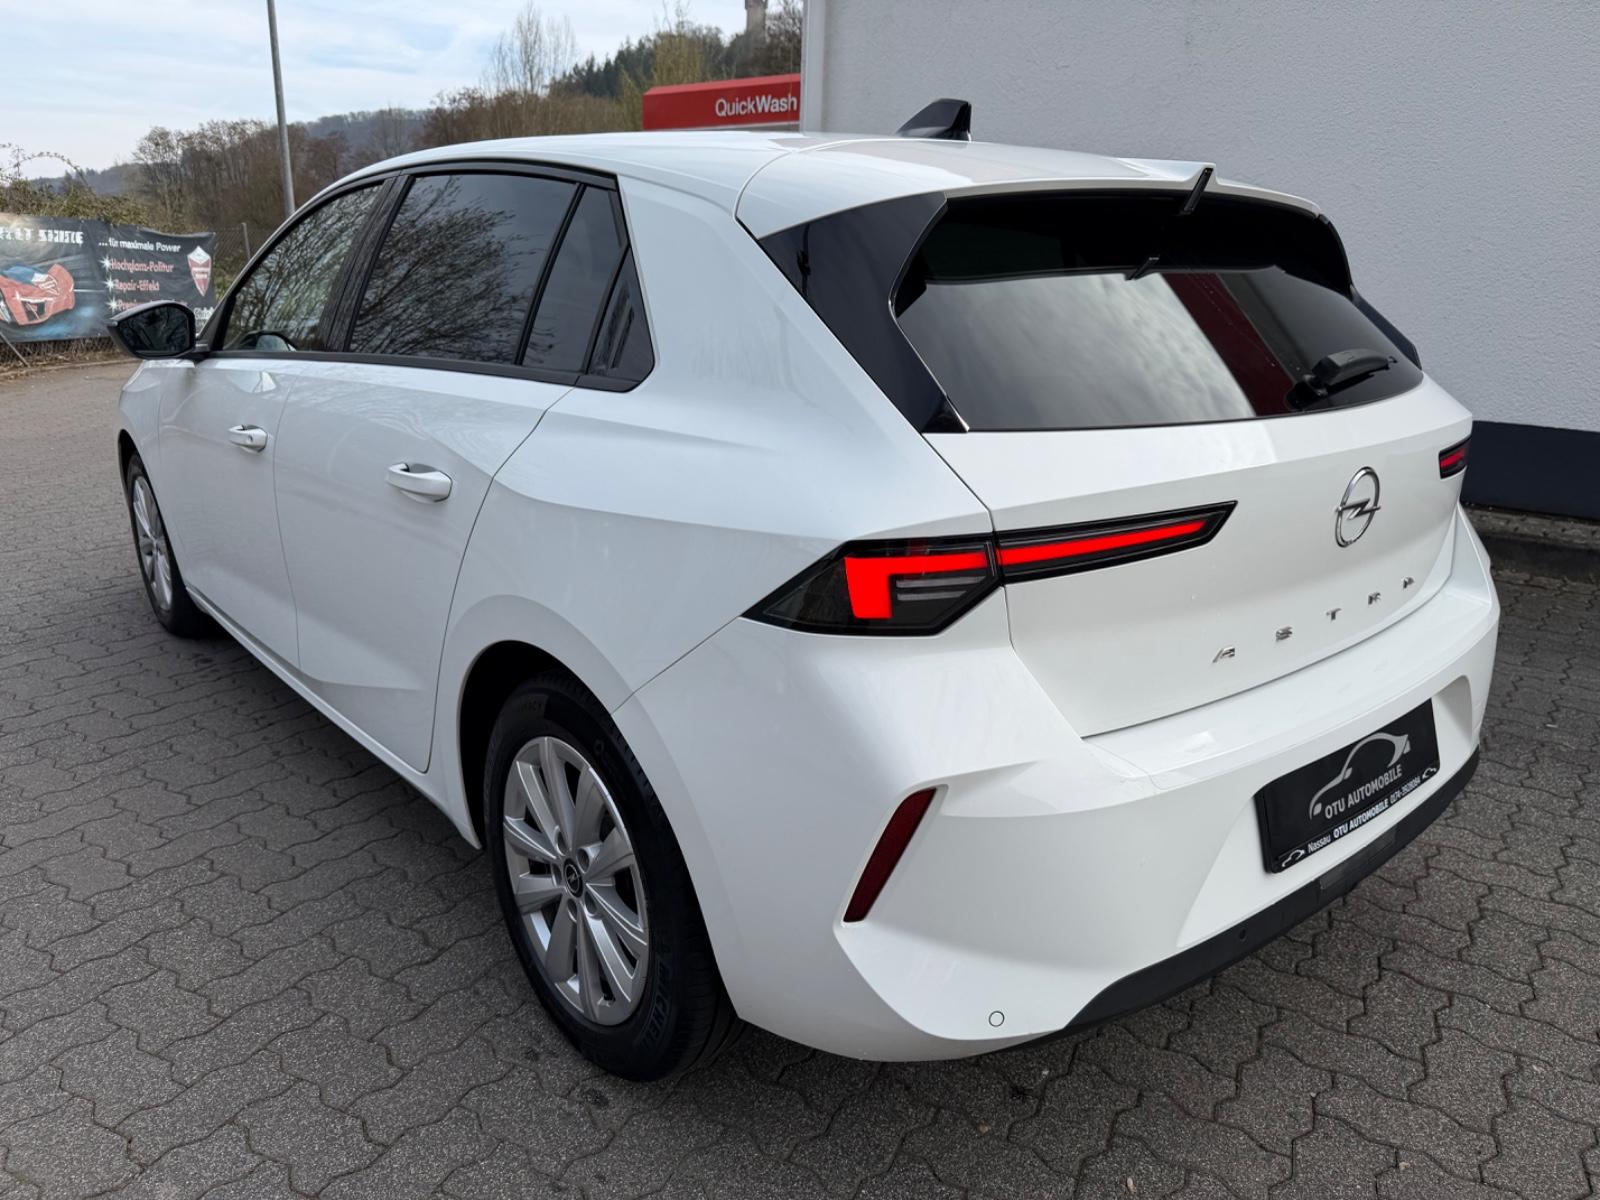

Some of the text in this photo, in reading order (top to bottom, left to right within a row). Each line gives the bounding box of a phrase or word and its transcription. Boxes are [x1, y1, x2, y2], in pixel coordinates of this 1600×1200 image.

[715, 93, 798, 118] QuickWash
[120, 240, 154, 251] maximale
[156, 242, 181, 252] Power
[1324, 764, 1402, 819] OTU AUTOMOBILE
[1308, 834, 1331, 853] Nassau
[1333, 825, 1349, 839] OTU
[1349, 799, 1389, 831] AUTOMOBILE
